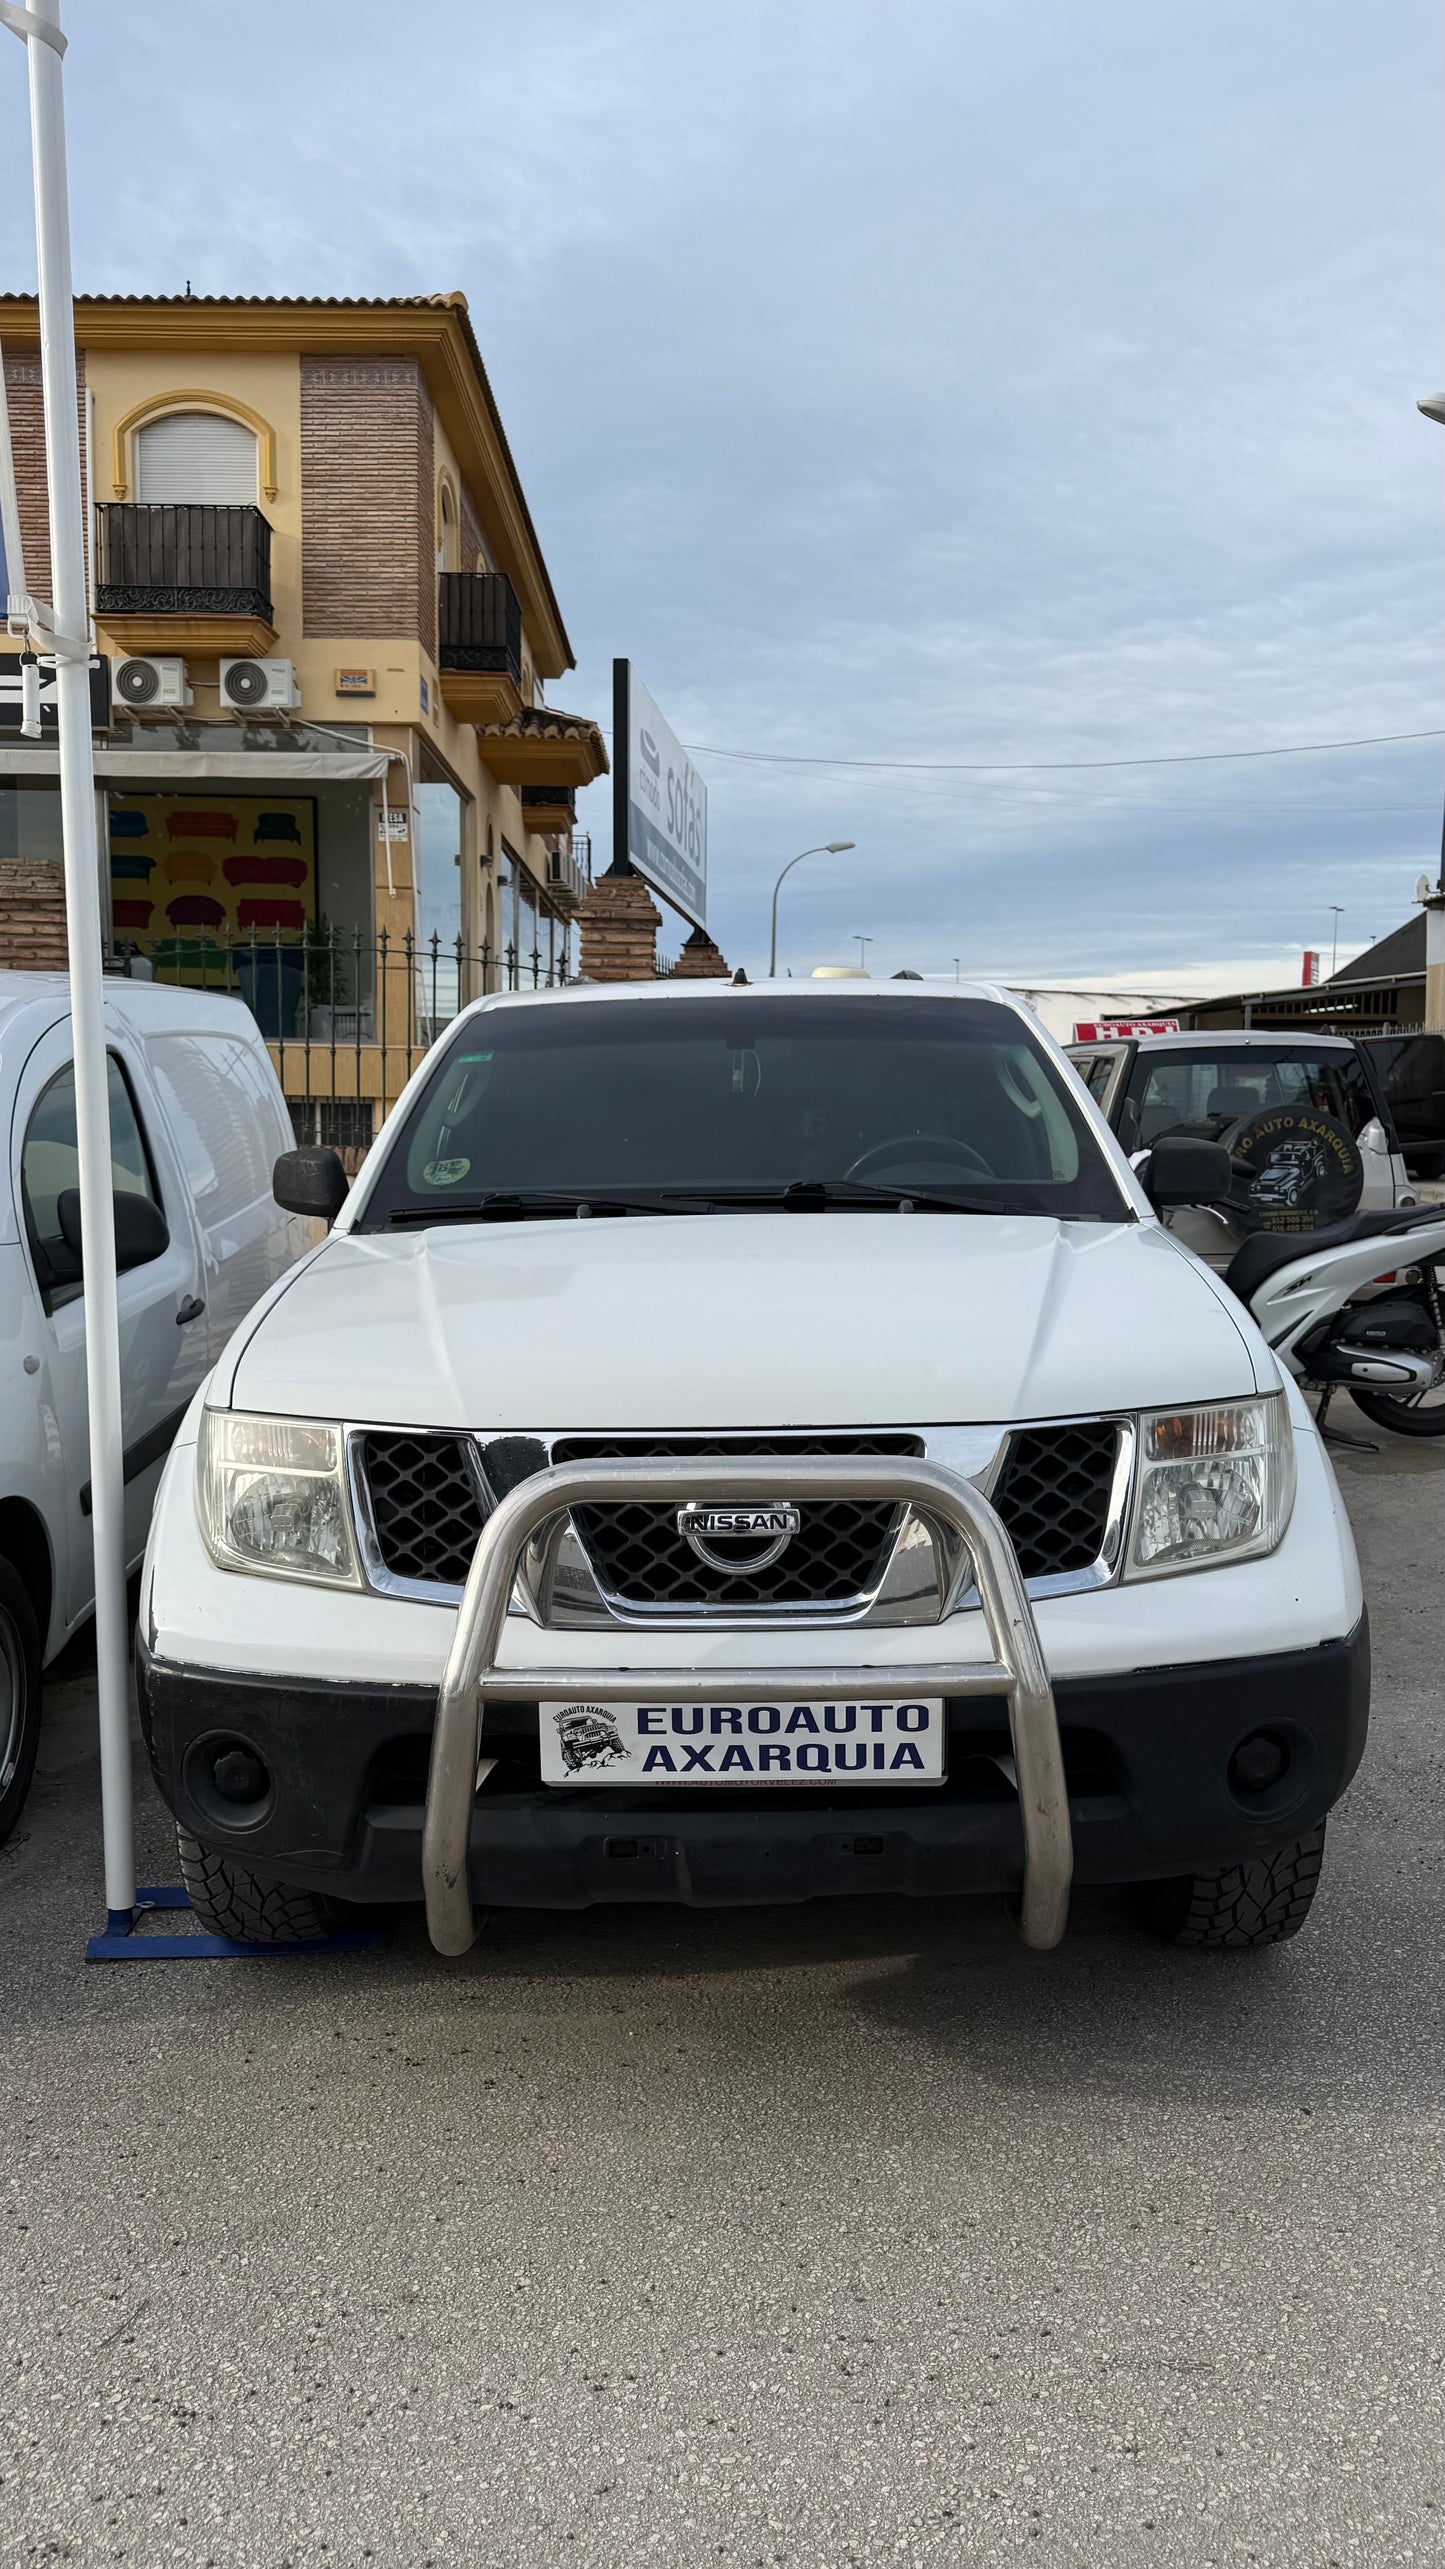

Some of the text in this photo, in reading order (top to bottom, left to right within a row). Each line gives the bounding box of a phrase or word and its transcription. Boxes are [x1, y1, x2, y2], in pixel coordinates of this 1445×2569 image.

[667, 762, 701, 867] sofás
[1255, 1116, 1294, 1140] AUTO
[1298, 1117, 1354, 1175] AXARQUIA
[690, 1514, 787, 1531] NISSAN
[552, 1705, 617, 1724] EUROAUTO AXARQUIA
[637, 1705, 929, 1735] EUROAUTO
[641, 1743, 925, 1773] AXARQUIA
